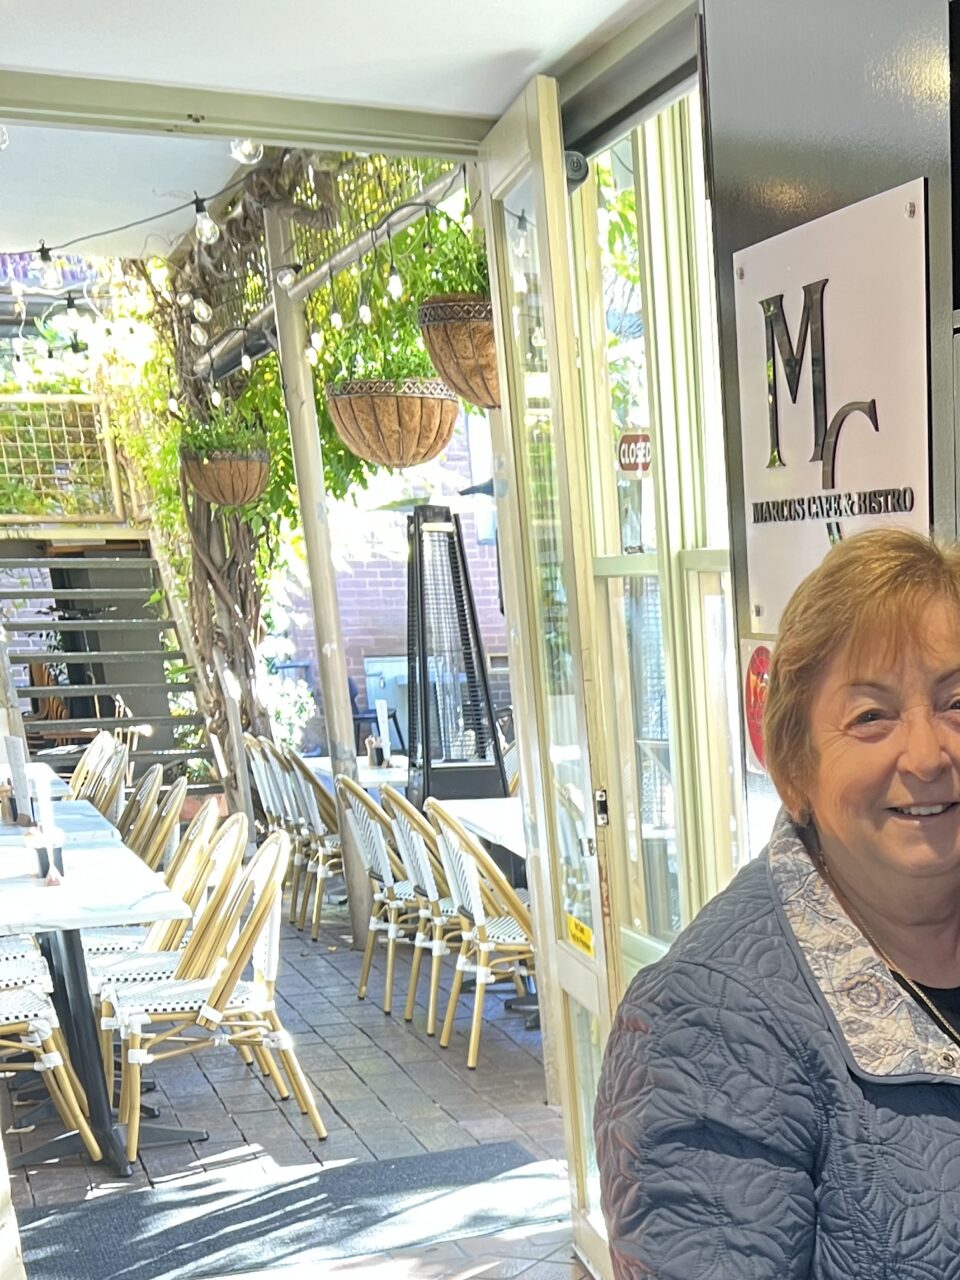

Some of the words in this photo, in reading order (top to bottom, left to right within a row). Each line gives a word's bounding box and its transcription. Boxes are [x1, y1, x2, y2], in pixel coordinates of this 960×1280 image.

[620, 441, 652, 465] CLOSED
[752, 497, 806, 524] MARCOS
[856, 486, 915, 515] BISTRO
